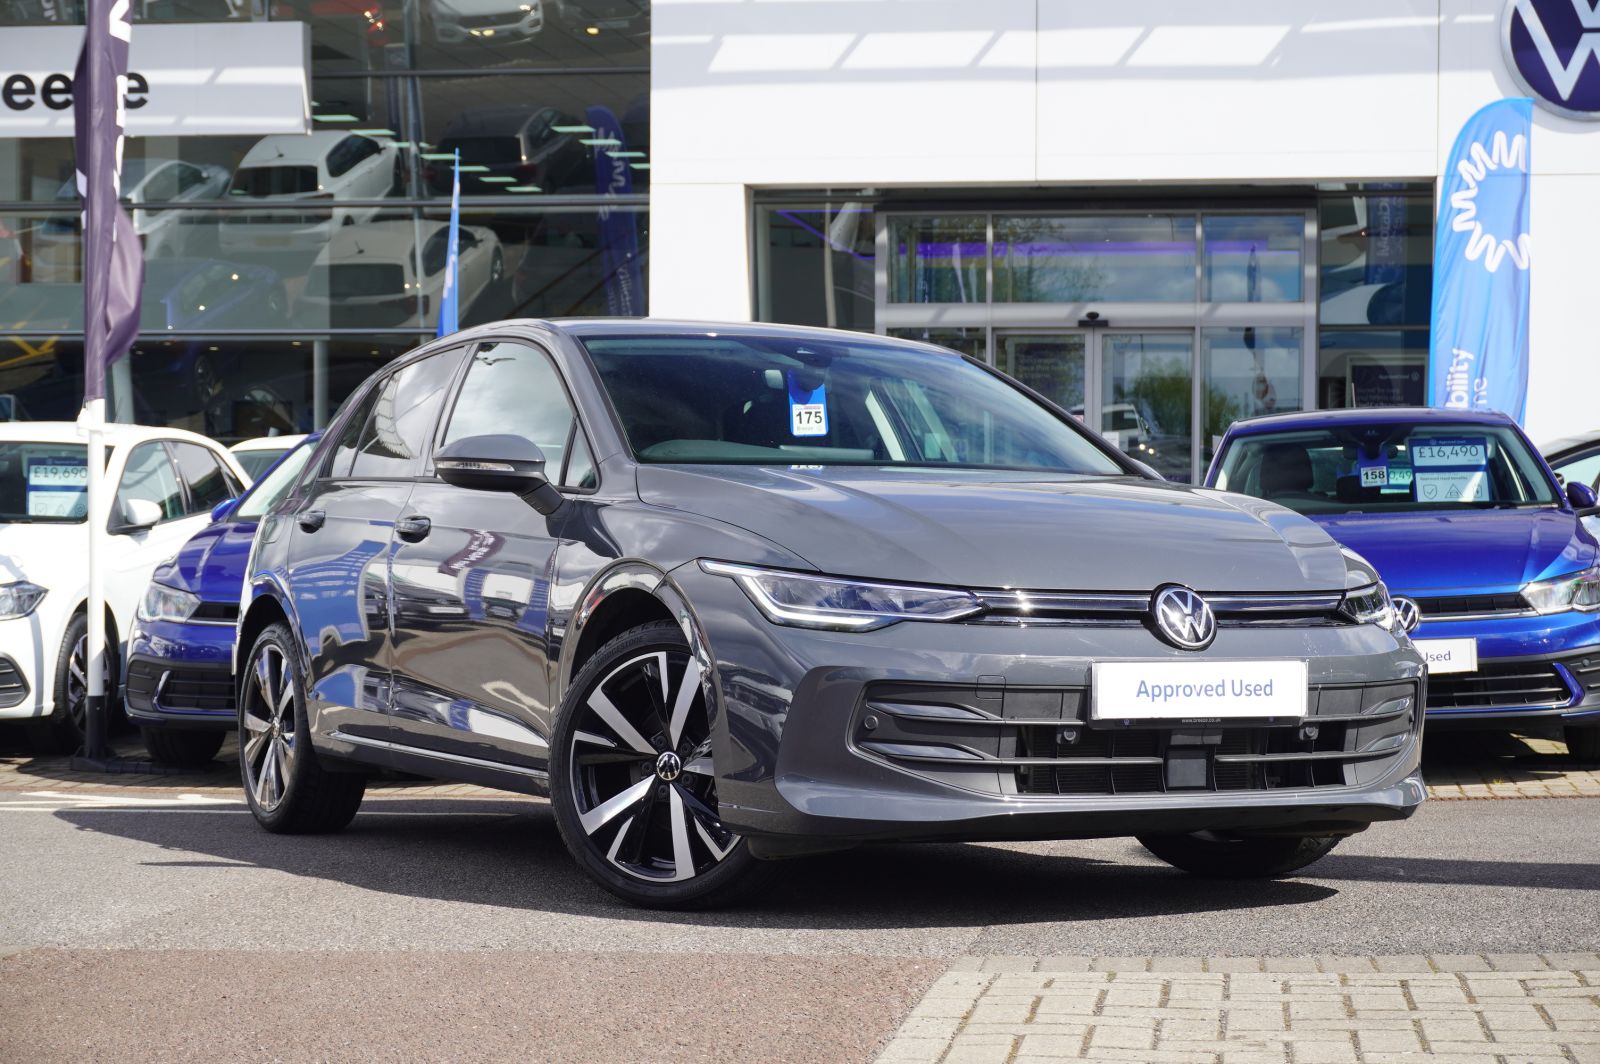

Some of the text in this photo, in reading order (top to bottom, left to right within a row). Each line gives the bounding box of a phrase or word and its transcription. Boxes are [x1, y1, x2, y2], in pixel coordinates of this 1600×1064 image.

[2, 72, 149, 111] eee
[796, 411, 822, 425] 175
[1418, 445, 1479, 460] £16,490
[34, 467, 88, 480] £19,690
[1363, 470, 1385, 480] 158
[1136, 678, 1273, 702] Approved Used
